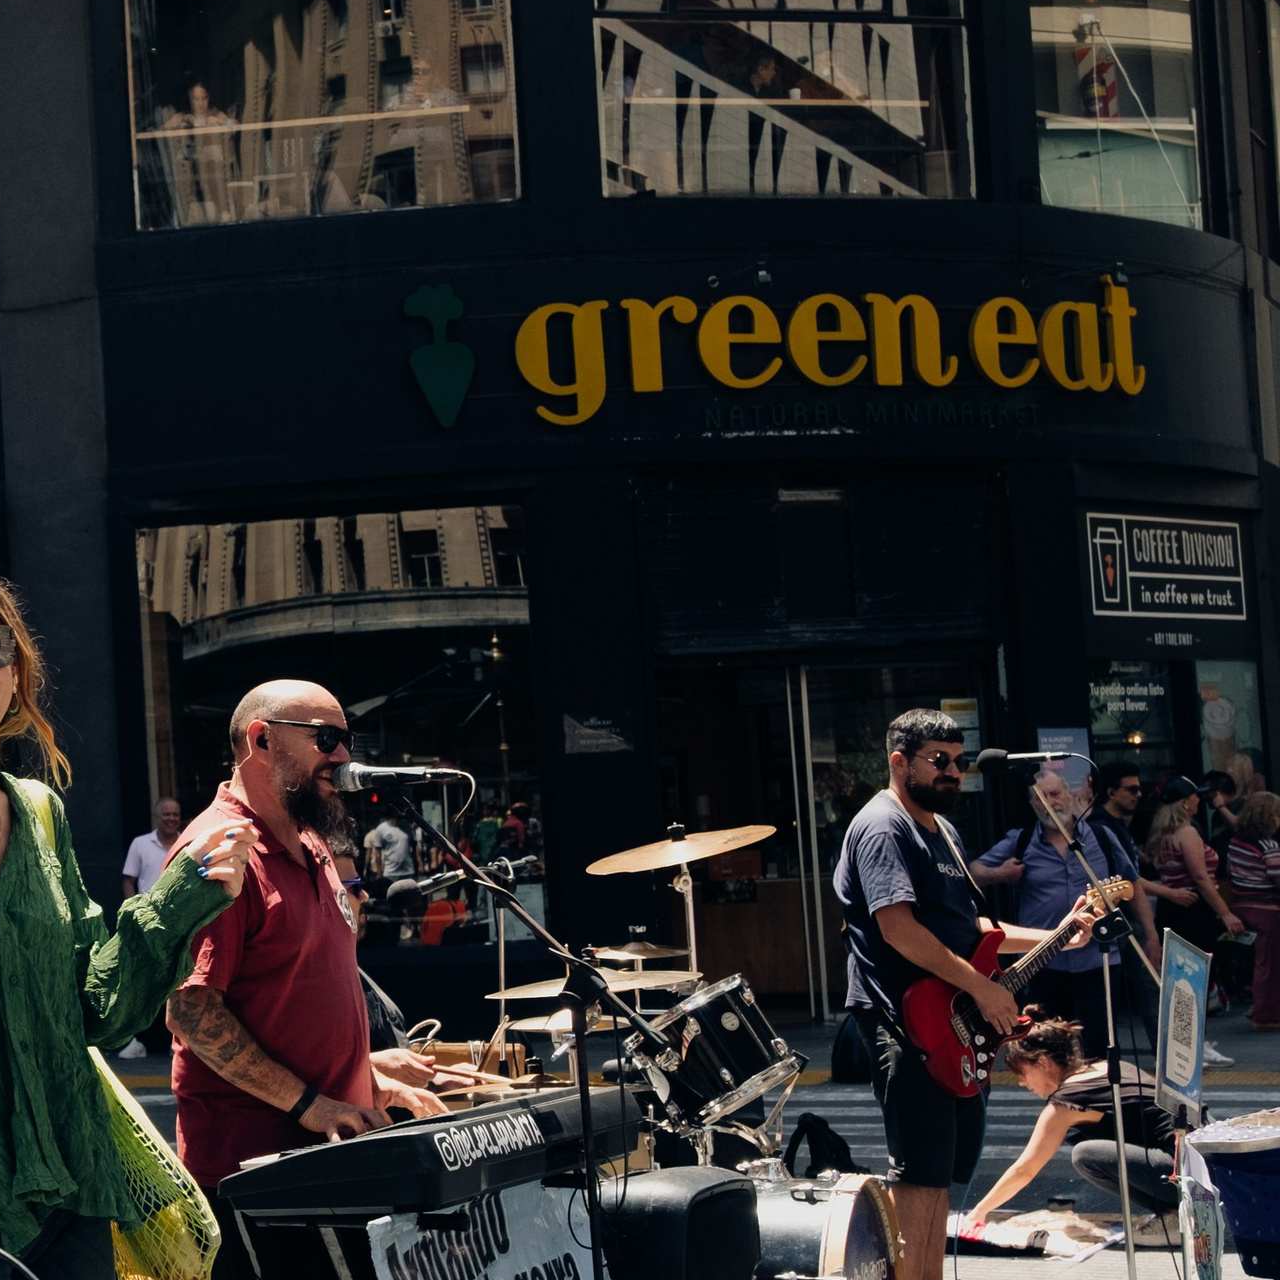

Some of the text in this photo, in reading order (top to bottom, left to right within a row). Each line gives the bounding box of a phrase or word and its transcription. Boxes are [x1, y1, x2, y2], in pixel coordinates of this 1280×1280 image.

[515, 274, 1146, 426] green eat
[703, 400, 1041, 430] NATURAL MINIMARKET
[1133, 528, 1181, 565] COFFEE
[1141, 583, 1236, 606] in coffee we trust.
[1088, 681, 1165, 700] Tu pedido online listo
[1106, 697, 1148, 715] para llevar.
